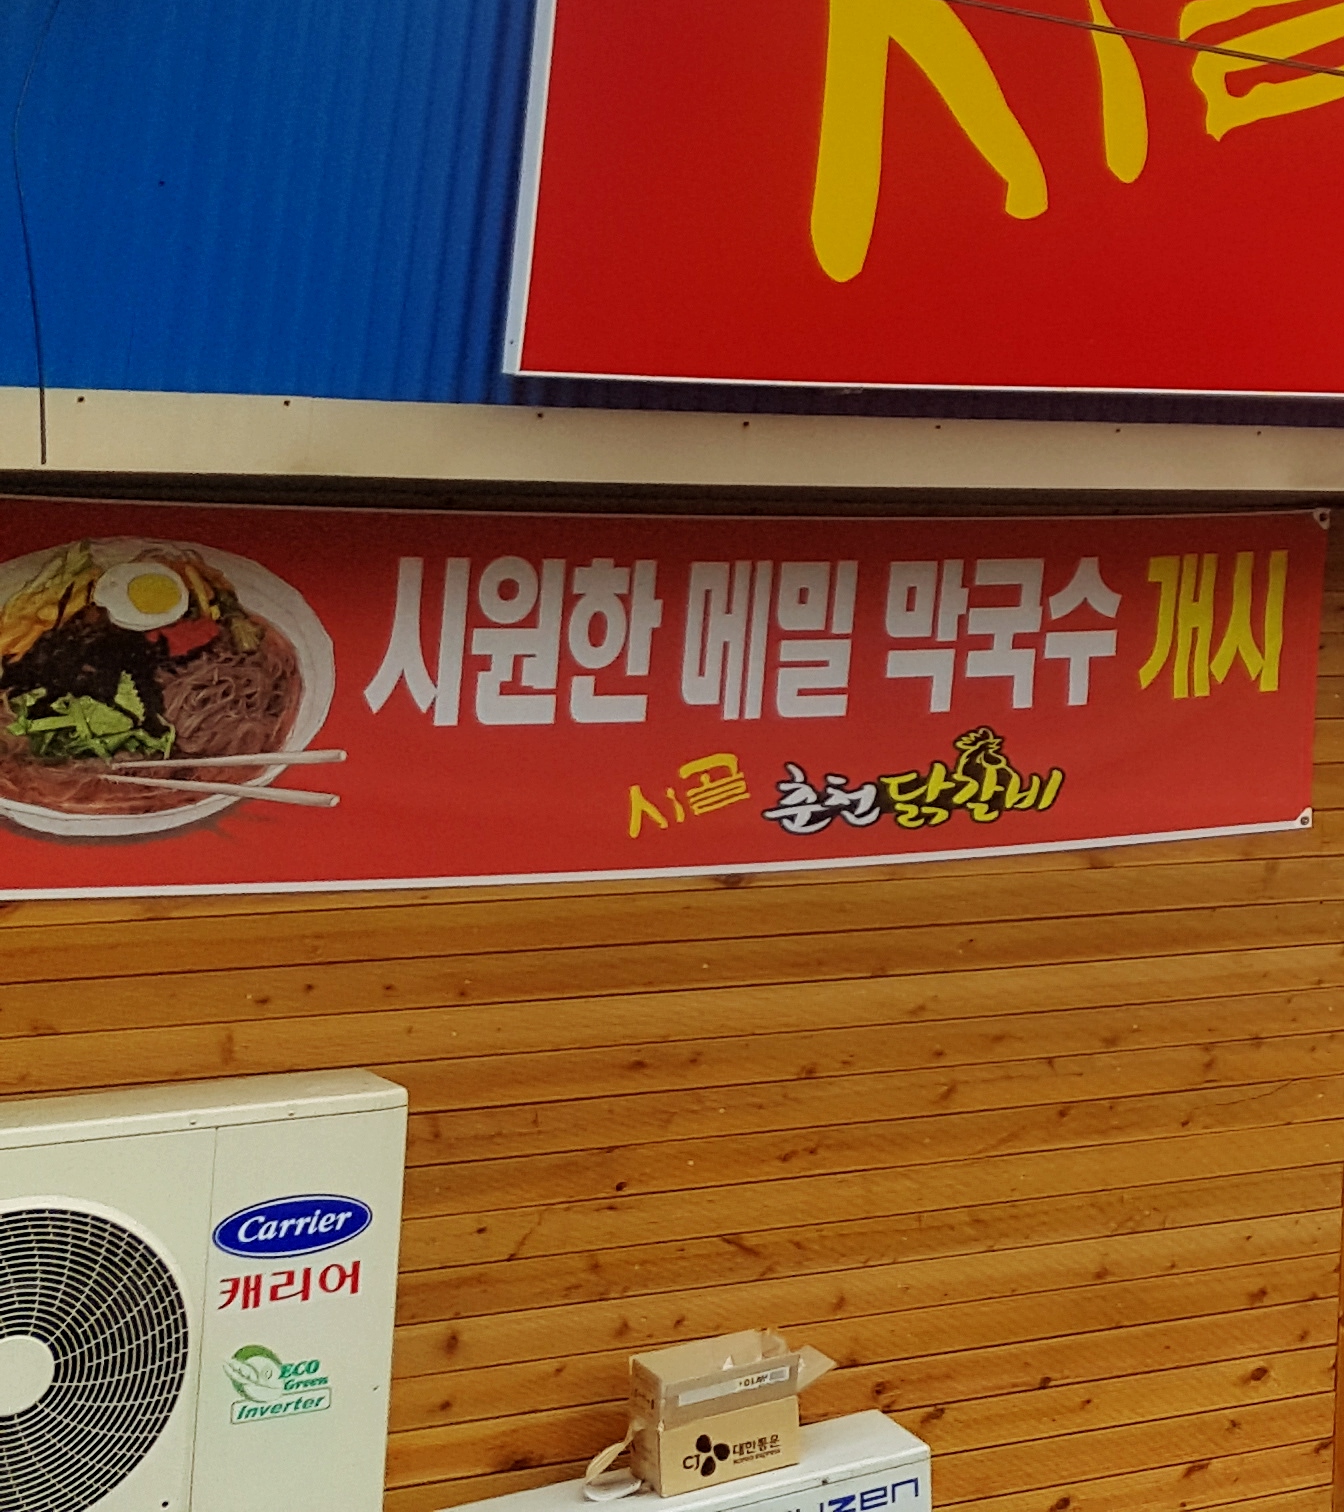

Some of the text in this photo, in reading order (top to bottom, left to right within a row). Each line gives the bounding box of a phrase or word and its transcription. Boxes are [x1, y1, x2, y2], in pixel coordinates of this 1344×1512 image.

[362, 550, 1289, 727] 시원한 메밀 막국수 개시
[628, 752, 752, 839] 시골
[237, 1209, 353, 1243] Carrier
[217, 1259, 361, 1310] 캐리어
[278, 1359, 320, 1379] ECO
[283, 1375, 329, 1392] Green
[236, 1394, 326, 1421] Inverter
[682, 1454, 701, 1471] CJ
